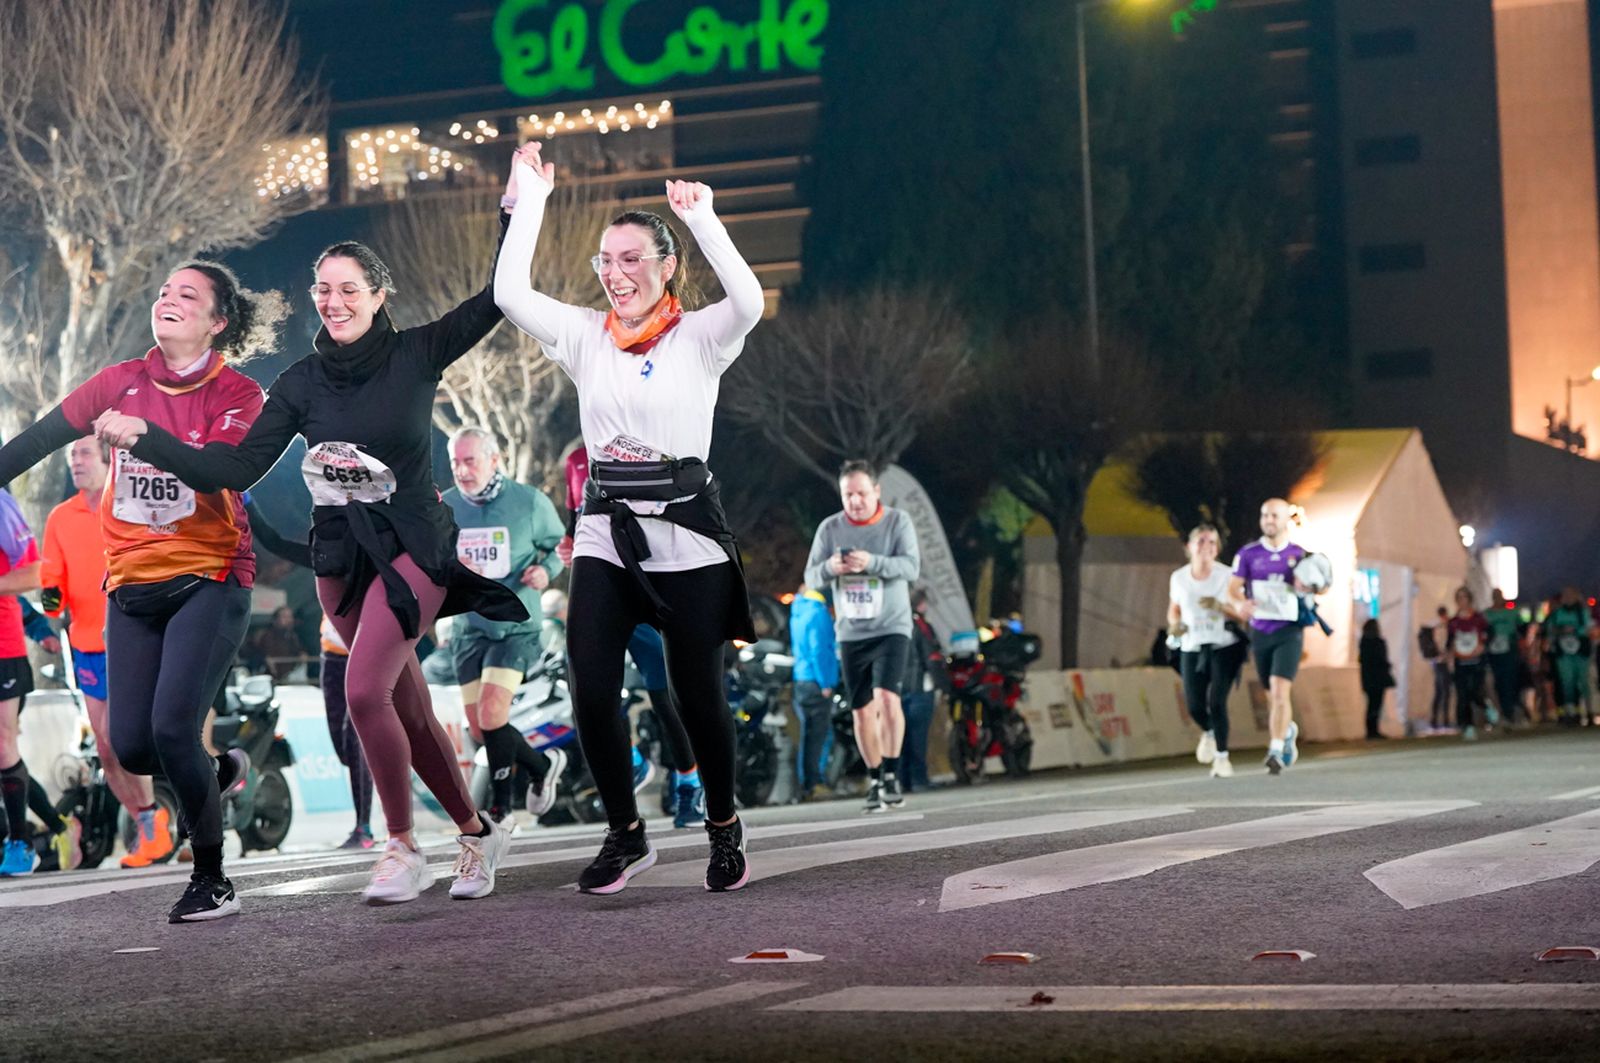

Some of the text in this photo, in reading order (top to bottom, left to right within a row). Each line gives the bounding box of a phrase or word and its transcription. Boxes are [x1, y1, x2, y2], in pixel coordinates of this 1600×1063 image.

[492, 0, 829, 97] El Corte
[603, 444, 620, 457] SAN
[616, 439, 641, 455] NOCHE
